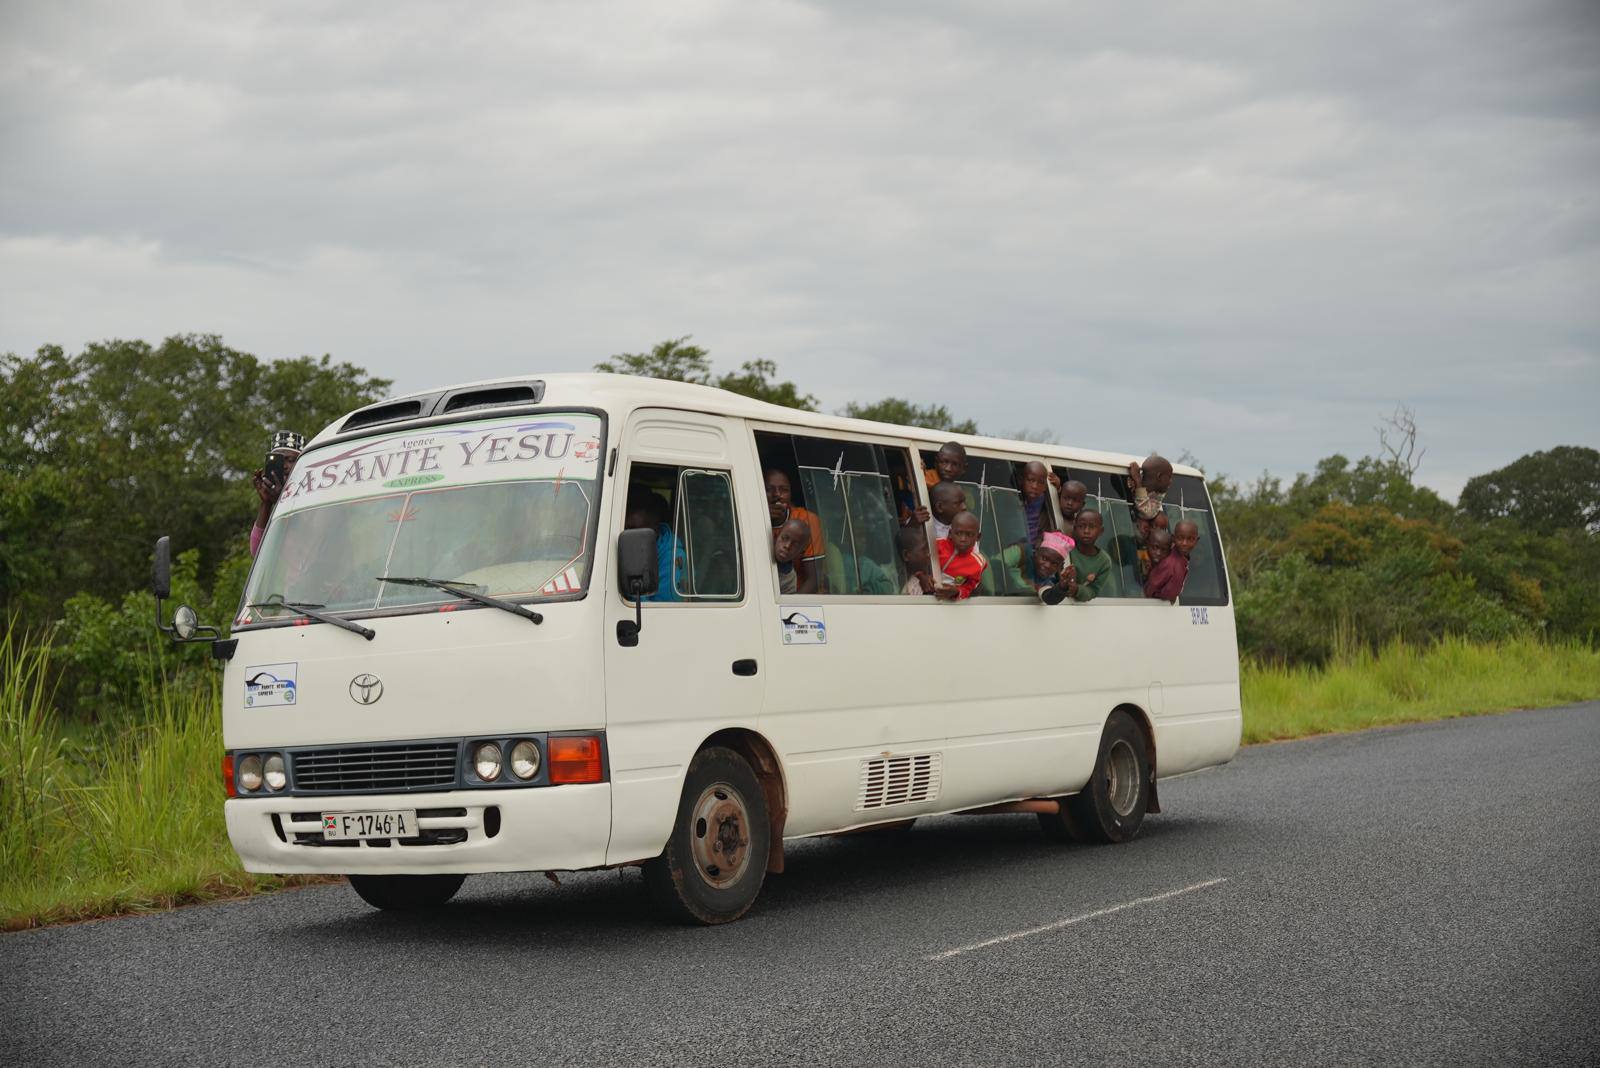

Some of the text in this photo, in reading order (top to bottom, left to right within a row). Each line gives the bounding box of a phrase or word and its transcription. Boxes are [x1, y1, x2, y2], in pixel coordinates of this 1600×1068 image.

[400, 437, 435, 450] Agence
[293, 432, 576, 497] ASANTE YESU
[389, 474, 438, 488] EXPRESS
